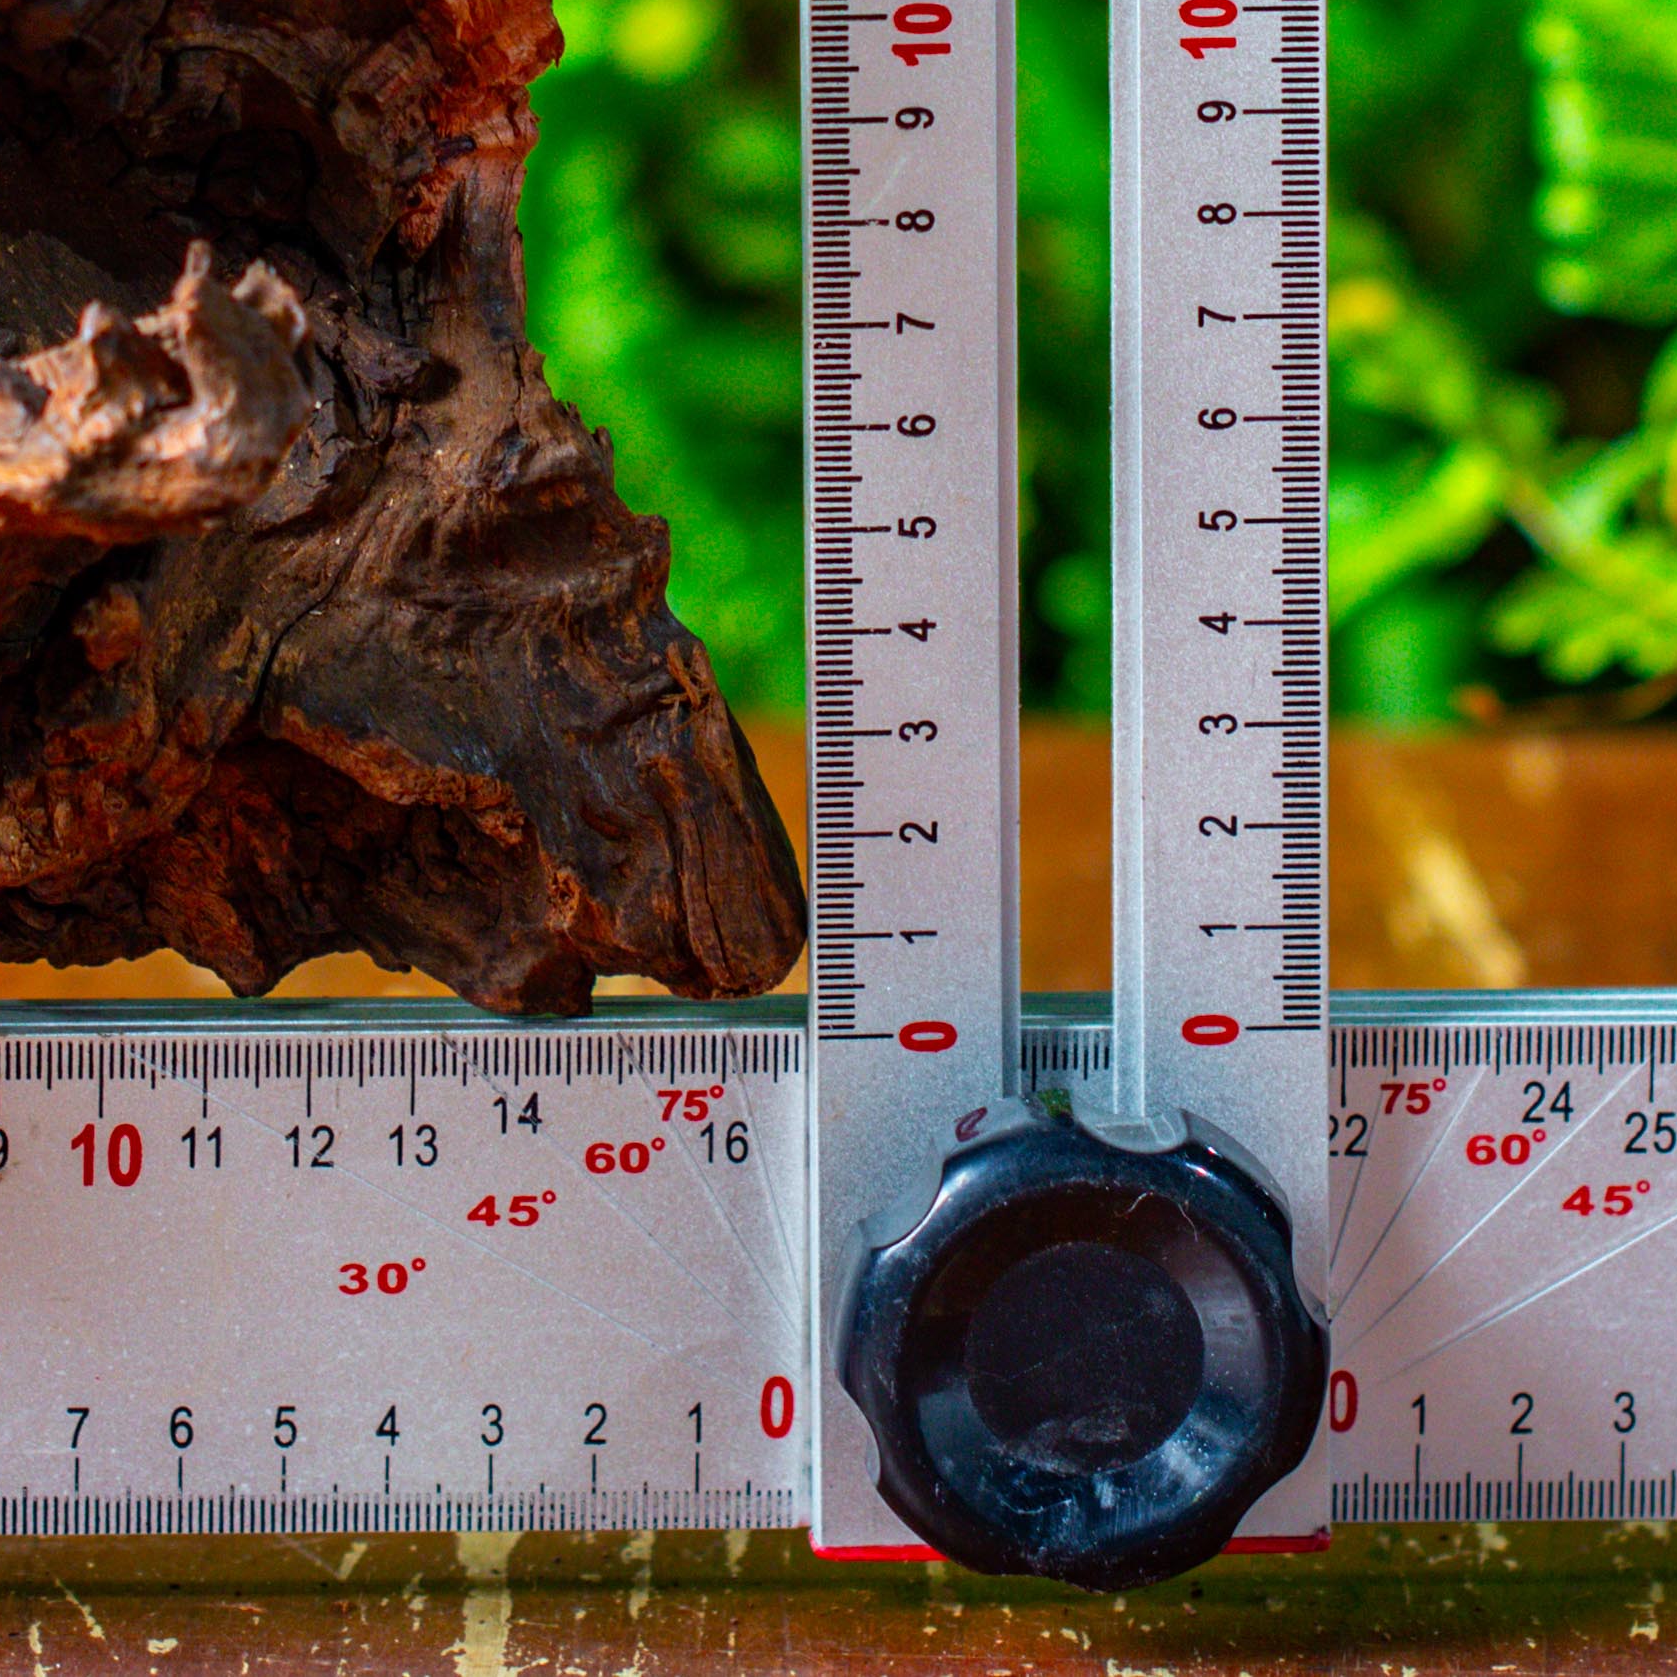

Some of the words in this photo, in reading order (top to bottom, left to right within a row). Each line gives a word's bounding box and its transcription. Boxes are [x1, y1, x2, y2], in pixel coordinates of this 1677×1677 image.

[891, 3, 952, 66] 10
[895, 107, 934, 130] 9
[1197, 101, 1236, 123] 9
[896, 209, 935, 232] 8
[1197, 203, 1237, 225] 8
[897, 313, 935, 334] 7
[1198, 306, 1236, 327] 7
[897, 414, 936, 437] 6
[1198, 408, 1237, 430] 6
[898, 516, 936, 539] 5
[1199, 510, 1237, 531] 5
[898, 619, 936, 642] 4
[1199, 612, 1237, 635] 4
[899, 720, 937, 742] 3
[1199, 714, 1237, 735] 3
[899, 821, 938, 843] 2
[1199, 815, 1237, 836] 2
[900, 931, 937, 944] 1
[1199, 924, 1237, 937] 1
[899, 1021, 957, 1052] 0
[1182, 1015, 1239, 1045] 0
[1522, 1081, 1573, 1123] 24
[1624, 1112, 1676, 1153] 25
[71, 1124, 142, 1187] 10
[182, 1126, 221, 1168] 11
[285, 1125, 334, 1167] 12
[389, 1124, 437, 1166] 13
[494, 1092, 542, 1134] 14
[701, 1121, 748, 1163] 16
[67, 1407, 89, 1448] 7
[170, 1406, 193, 1448] 6
[274, 1406, 297, 1448] 5
[376, 1405, 400, 1446] 4
[481, 1404, 503, 1446] 3
[584, 1403, 607, 1445] 2
[688, 1402, 701, 1443] 1
[760, 1376, 794, 1439] 0
[1330, 1370, 1358, 1432] 0
[1412, 1394, 1425, 1434] 1
[1510, 1392, 1533, 1434] 2
[1614, 1392, 1636, 1433] 3
